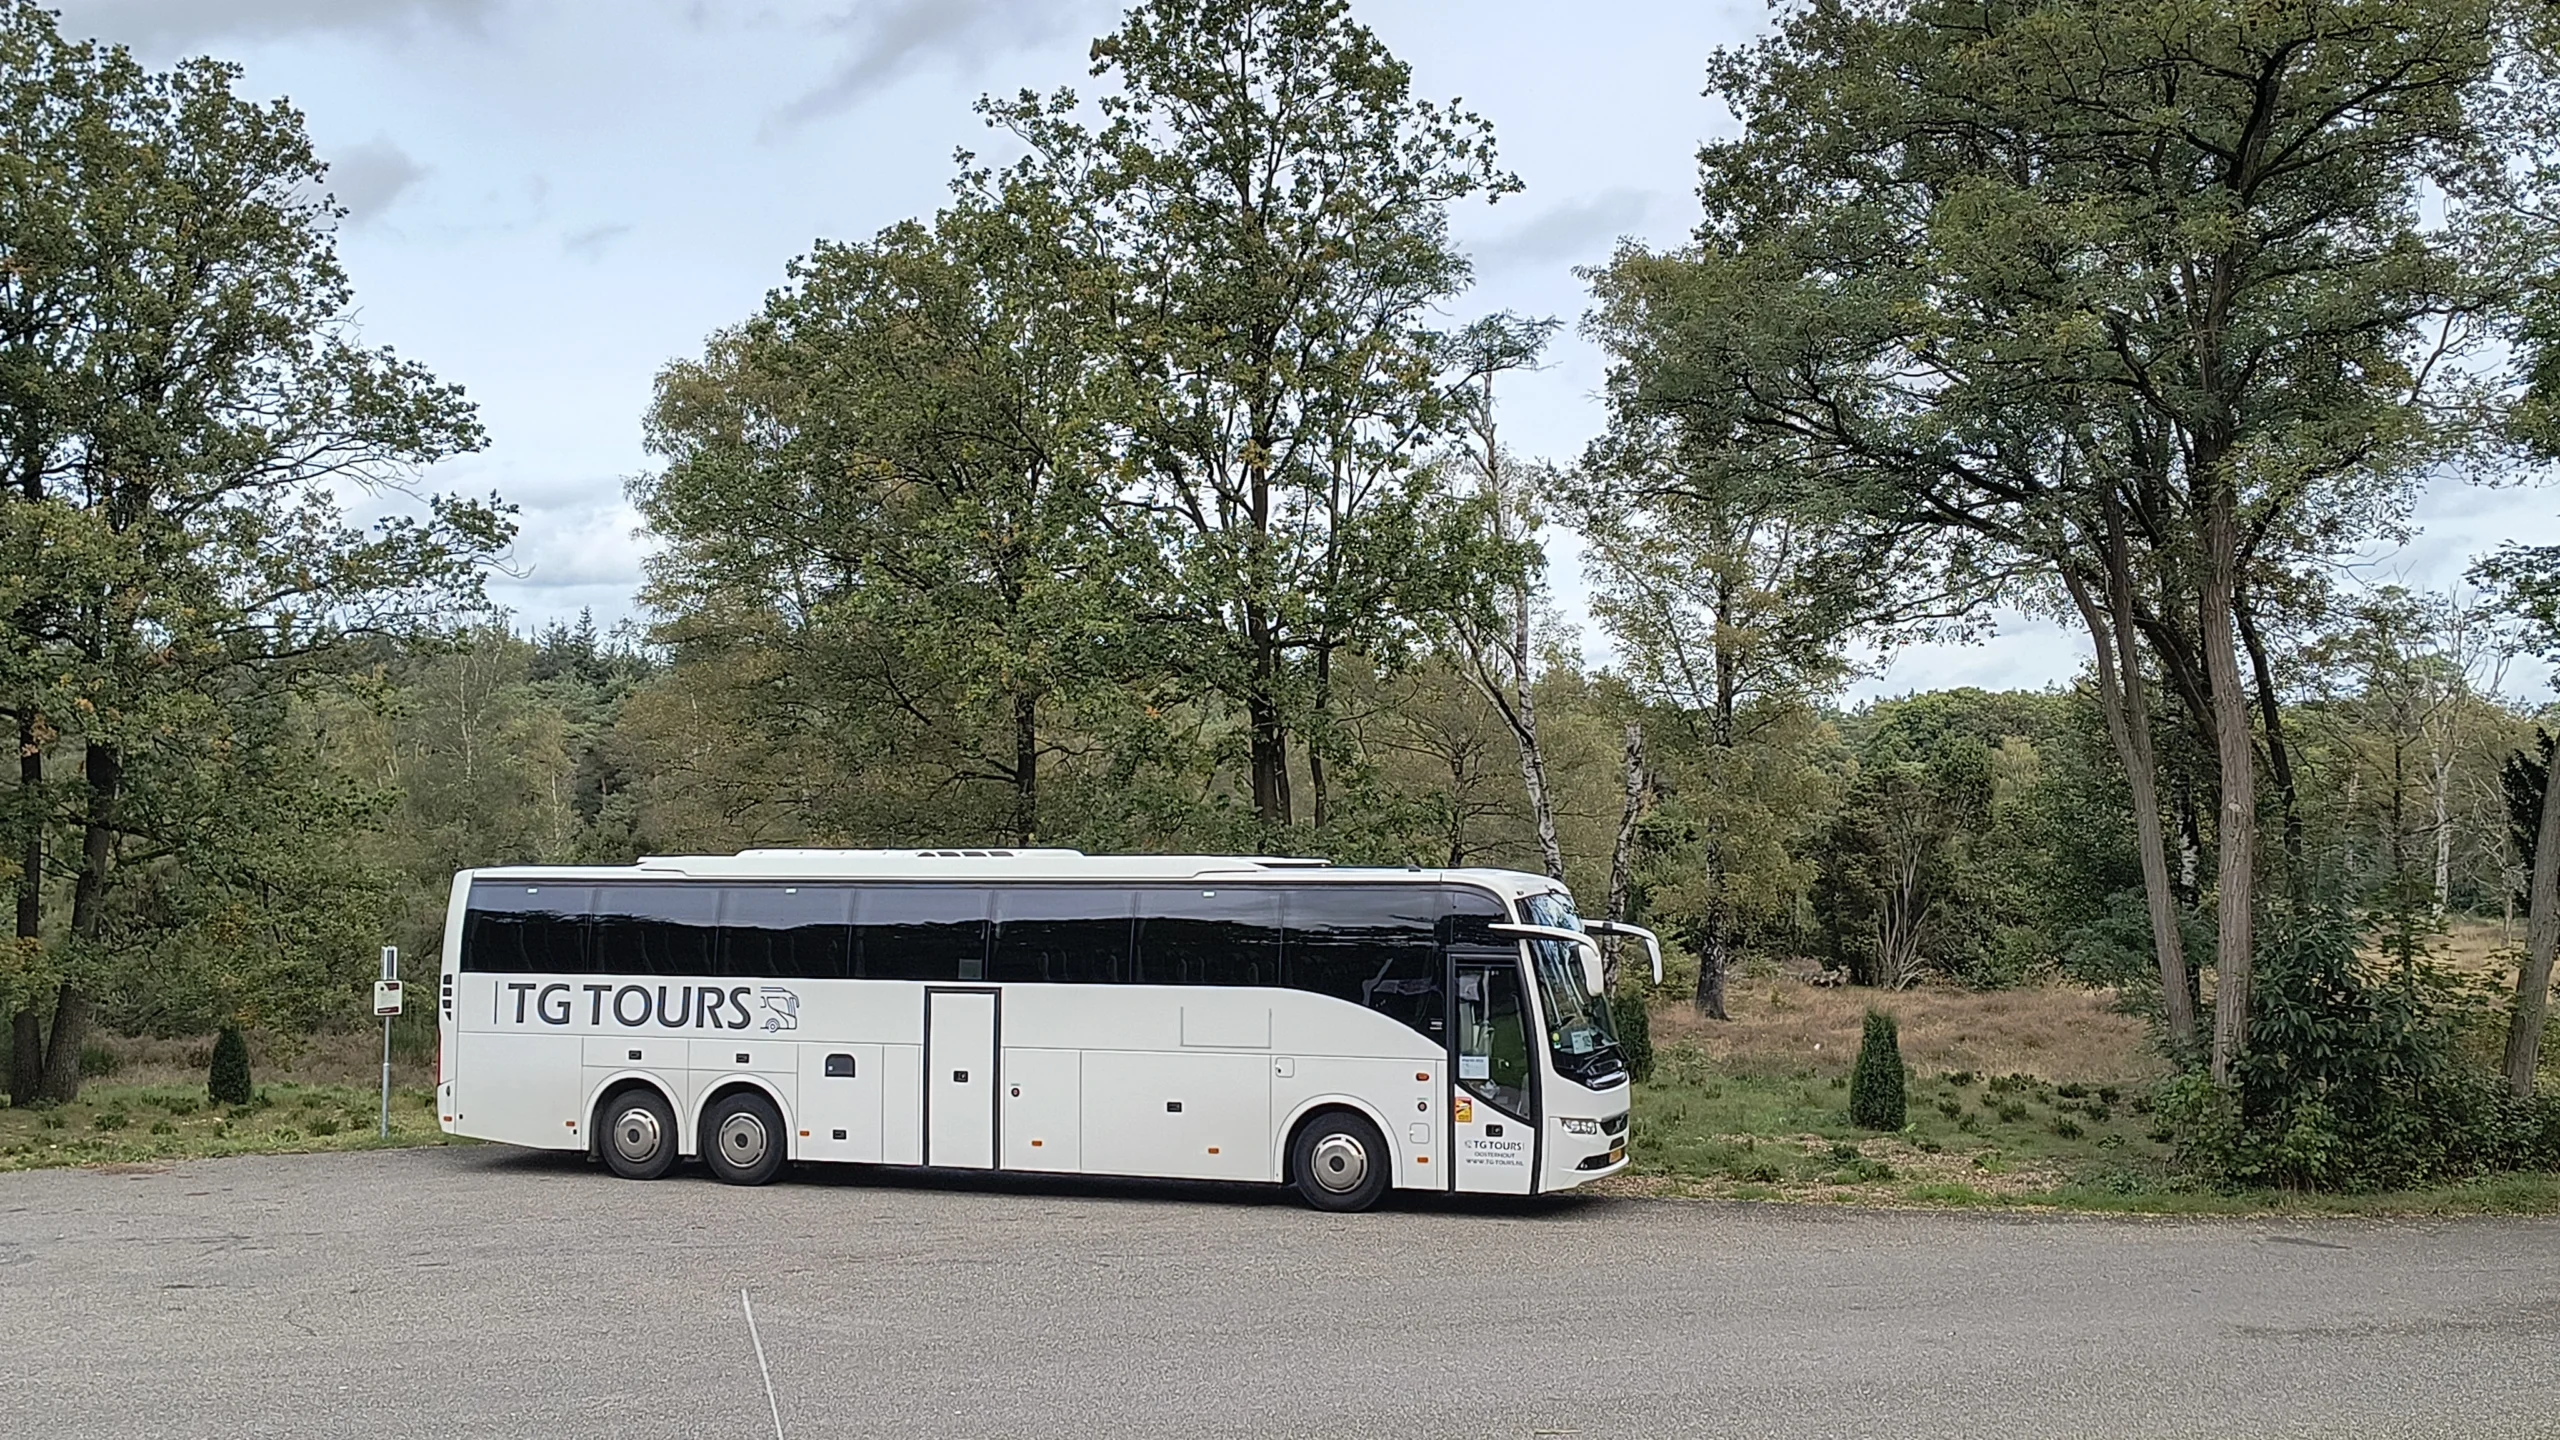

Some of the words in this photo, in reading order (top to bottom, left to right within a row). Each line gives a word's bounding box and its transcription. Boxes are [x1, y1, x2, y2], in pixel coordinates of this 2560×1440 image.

[508, 983, 571, 1025] TG
[583, 984, 751, 1029] TOURS
[1473, 1140, 1487, 1149] TG
[1489, 1141, 1521, 1151] TOURS
[1474, 1151, 1515, 1159] OOSTERHOUT
